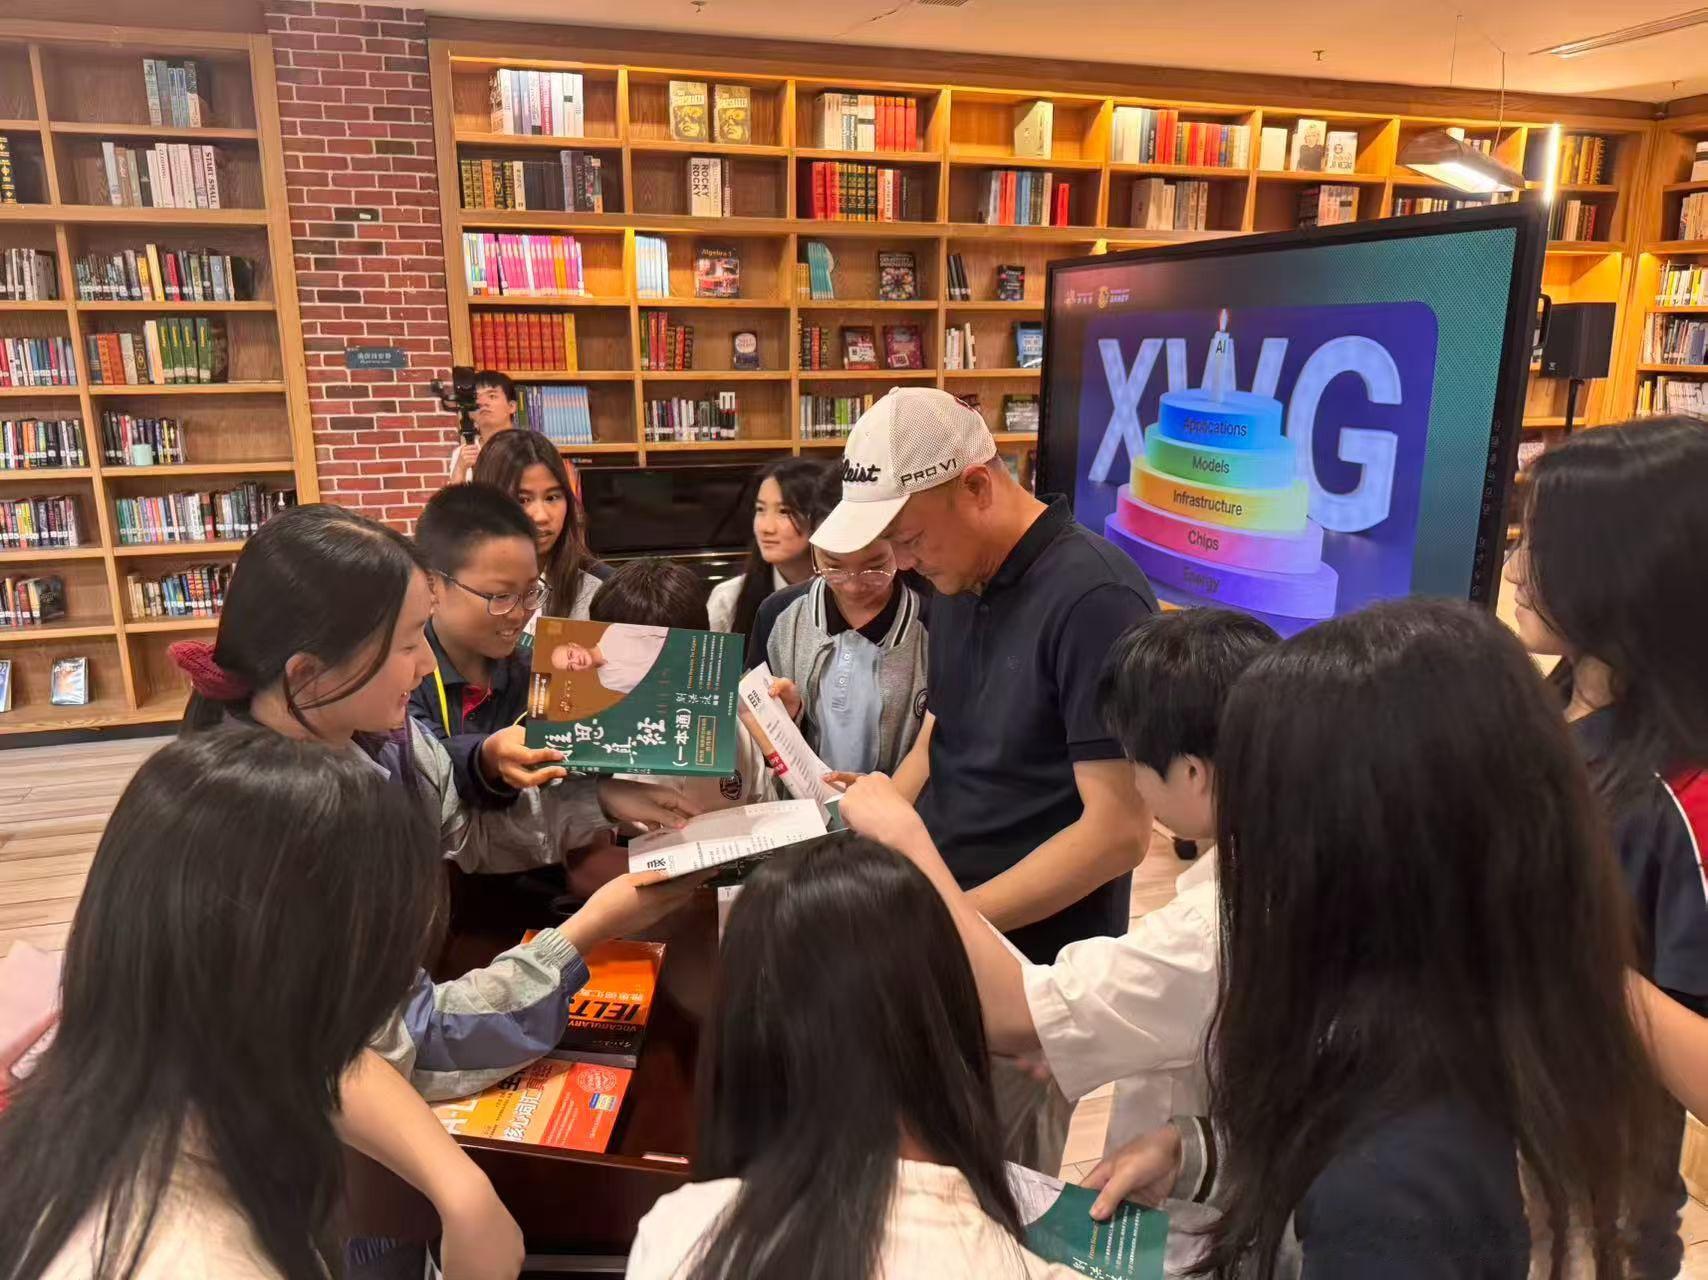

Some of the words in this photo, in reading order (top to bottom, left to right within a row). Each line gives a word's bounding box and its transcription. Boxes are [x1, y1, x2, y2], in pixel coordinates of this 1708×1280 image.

[205, 152, 215, 177] START
[207, 178, 218, 205] SMALL
[692, 164, 701, 197] ROCKY
[701, 164, 710, 198] ROCKY
[1215, 341, 1226, 354] AI
[1183, 417, 1248, 437] Applications
[841, 459, 881, 483] leist
[901, 467, 937, 486] PRO
[1191, 455, 1230, 475] Models
[1173, 489, 1243, 517] Infrastructure
[1187, 530, 1220, 553] Chips
[1184, 568, 1220, 593] Energy
[569, 1001, 641, 1022] IELT
[569, 1020, 637, 1032] VOCABULARY
